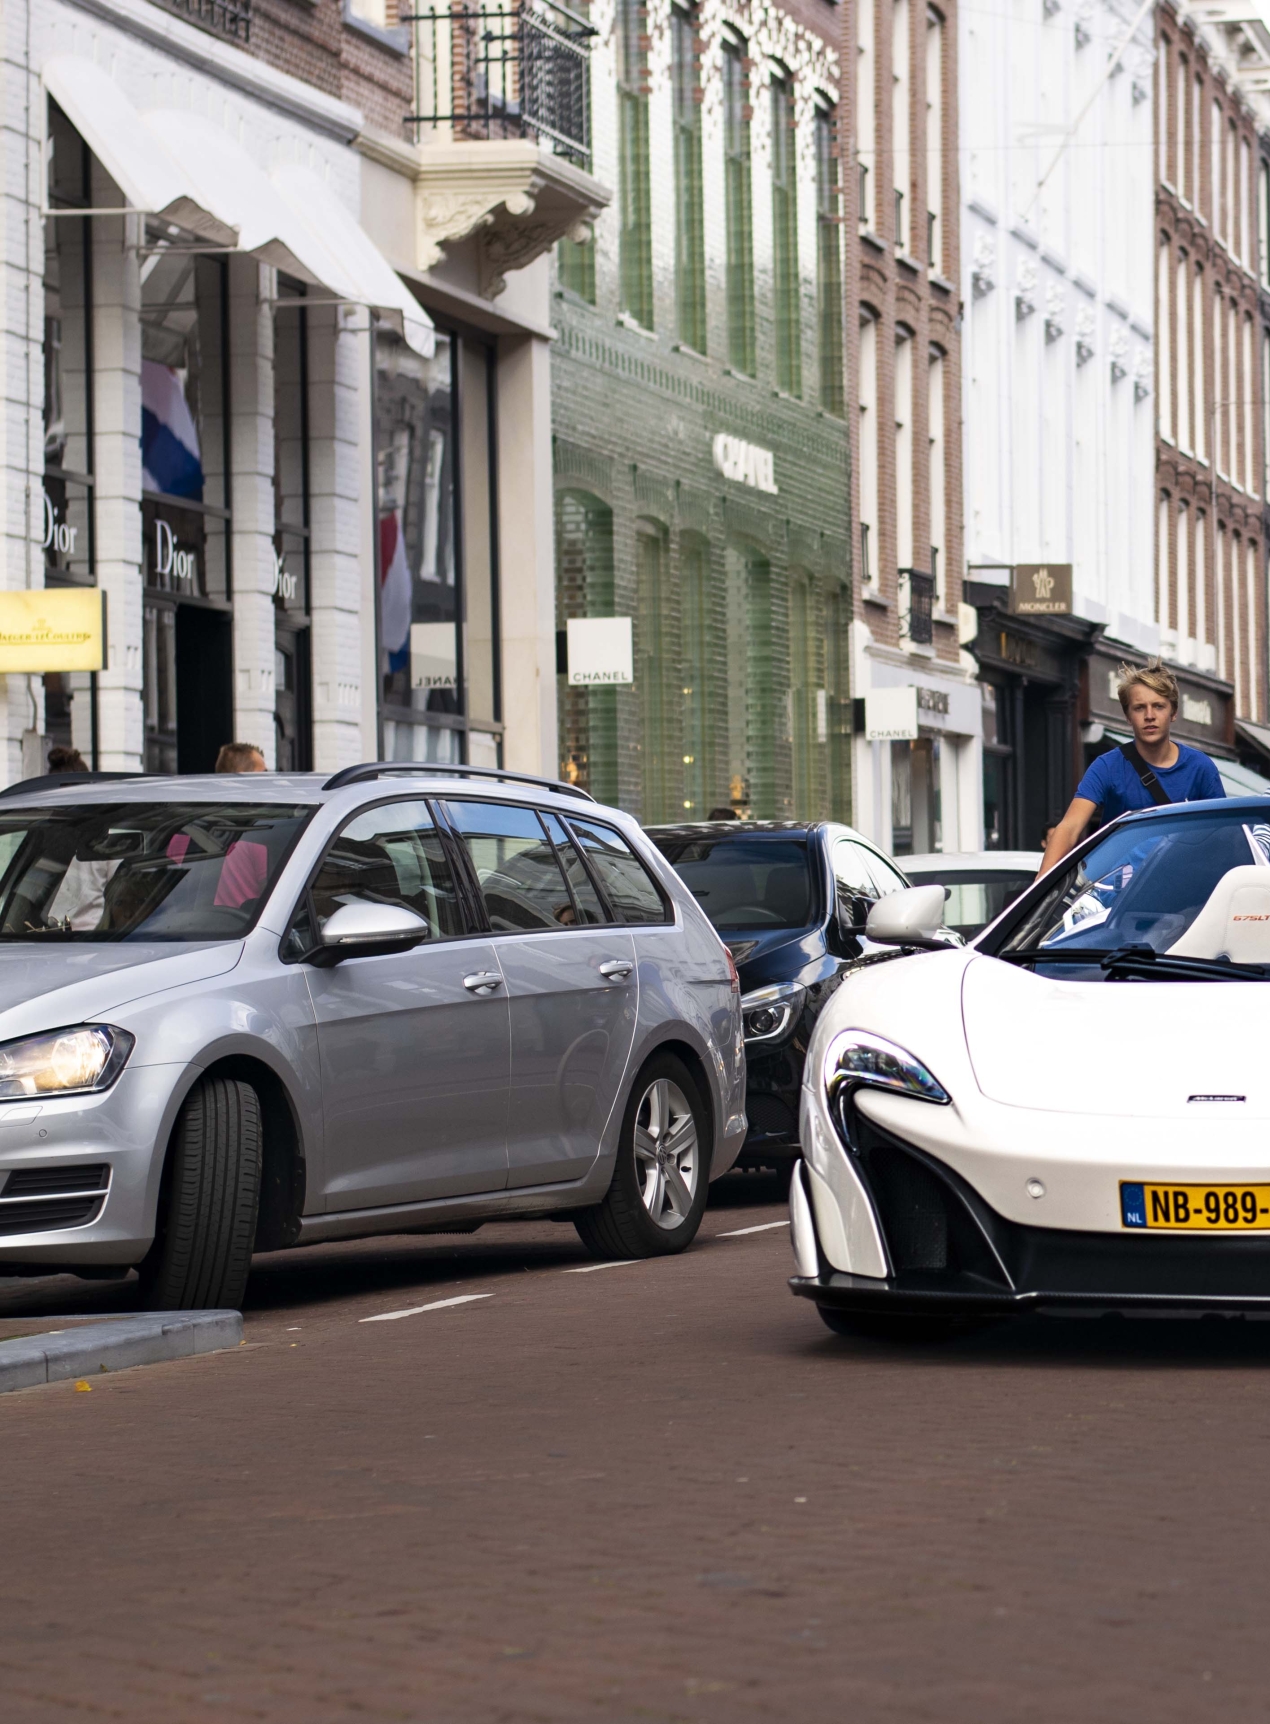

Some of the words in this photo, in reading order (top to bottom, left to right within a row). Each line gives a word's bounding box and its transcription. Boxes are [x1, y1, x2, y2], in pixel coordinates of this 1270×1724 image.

[154, 518, 194, 579] Dior
[1019, 602, 1067, 611] MONCLER
[573, 671, 628, 683] CHANEL
[870, 729, 914, 739] CHANEL
[1127, 1212, 1143, 1224] NL
